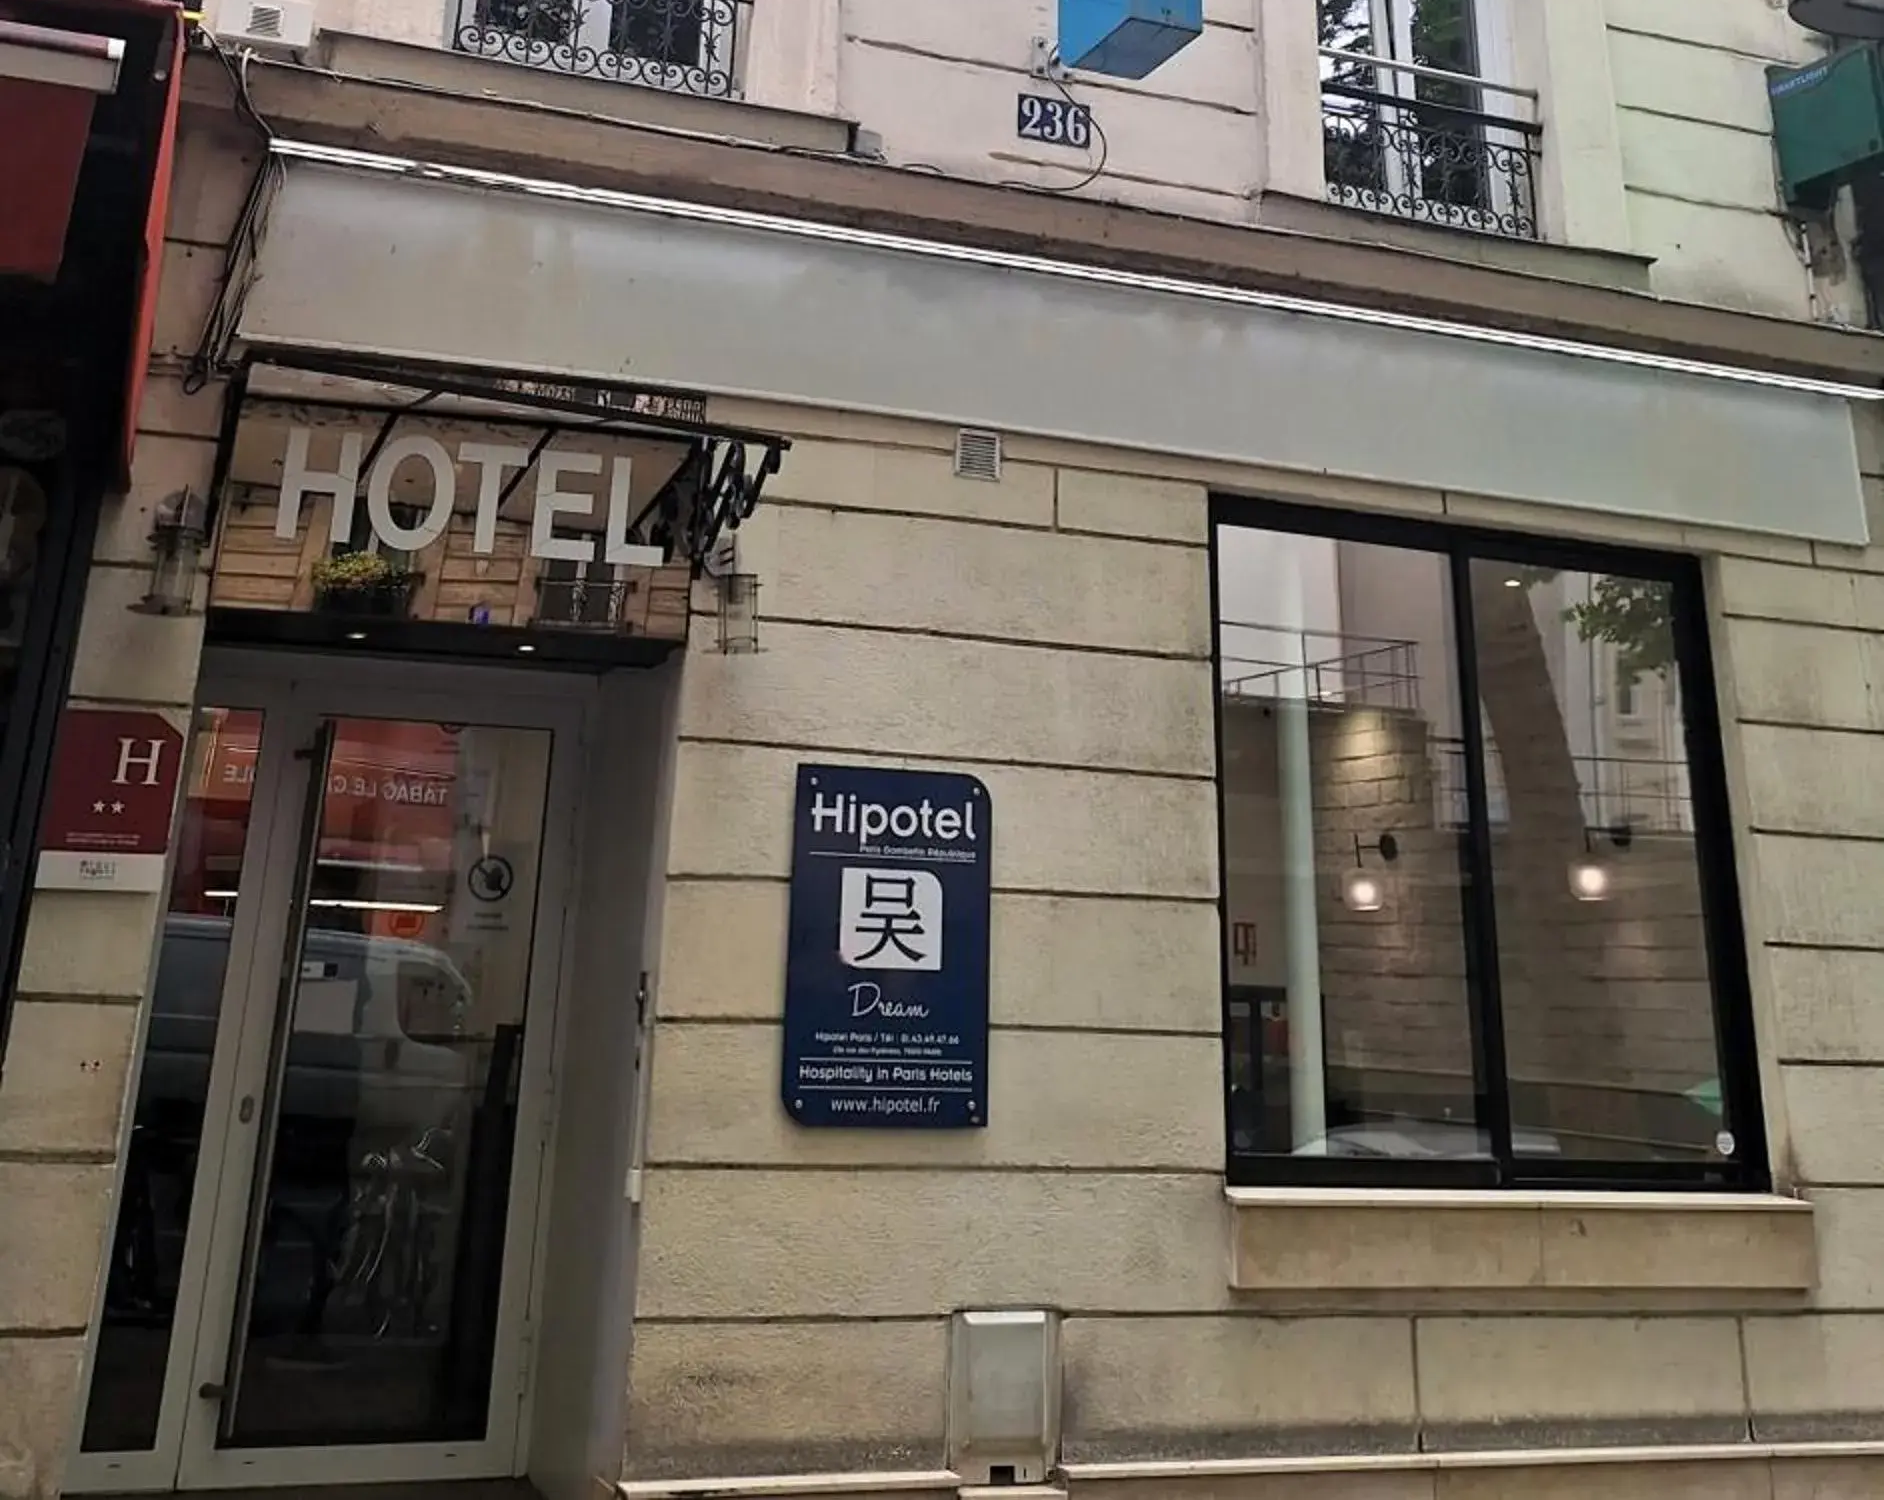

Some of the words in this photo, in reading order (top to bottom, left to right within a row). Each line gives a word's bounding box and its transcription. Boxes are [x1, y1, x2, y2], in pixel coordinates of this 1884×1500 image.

[1021, 98, 1087, 145] 236
[274, 426, 665, 568] HOTEL
[111, 737, 167, 786] H
[811, 792, 977, 845] Hipotel
[847, 981, 930, 1018] Dream
[800, 1064, 873, 1083] Hospitality
[892, 1066, 927, 1081] Paris
[929, 1067, 973, 1083] Hotels
[831, 1095, 941, 1115] www.hipotel.fr
